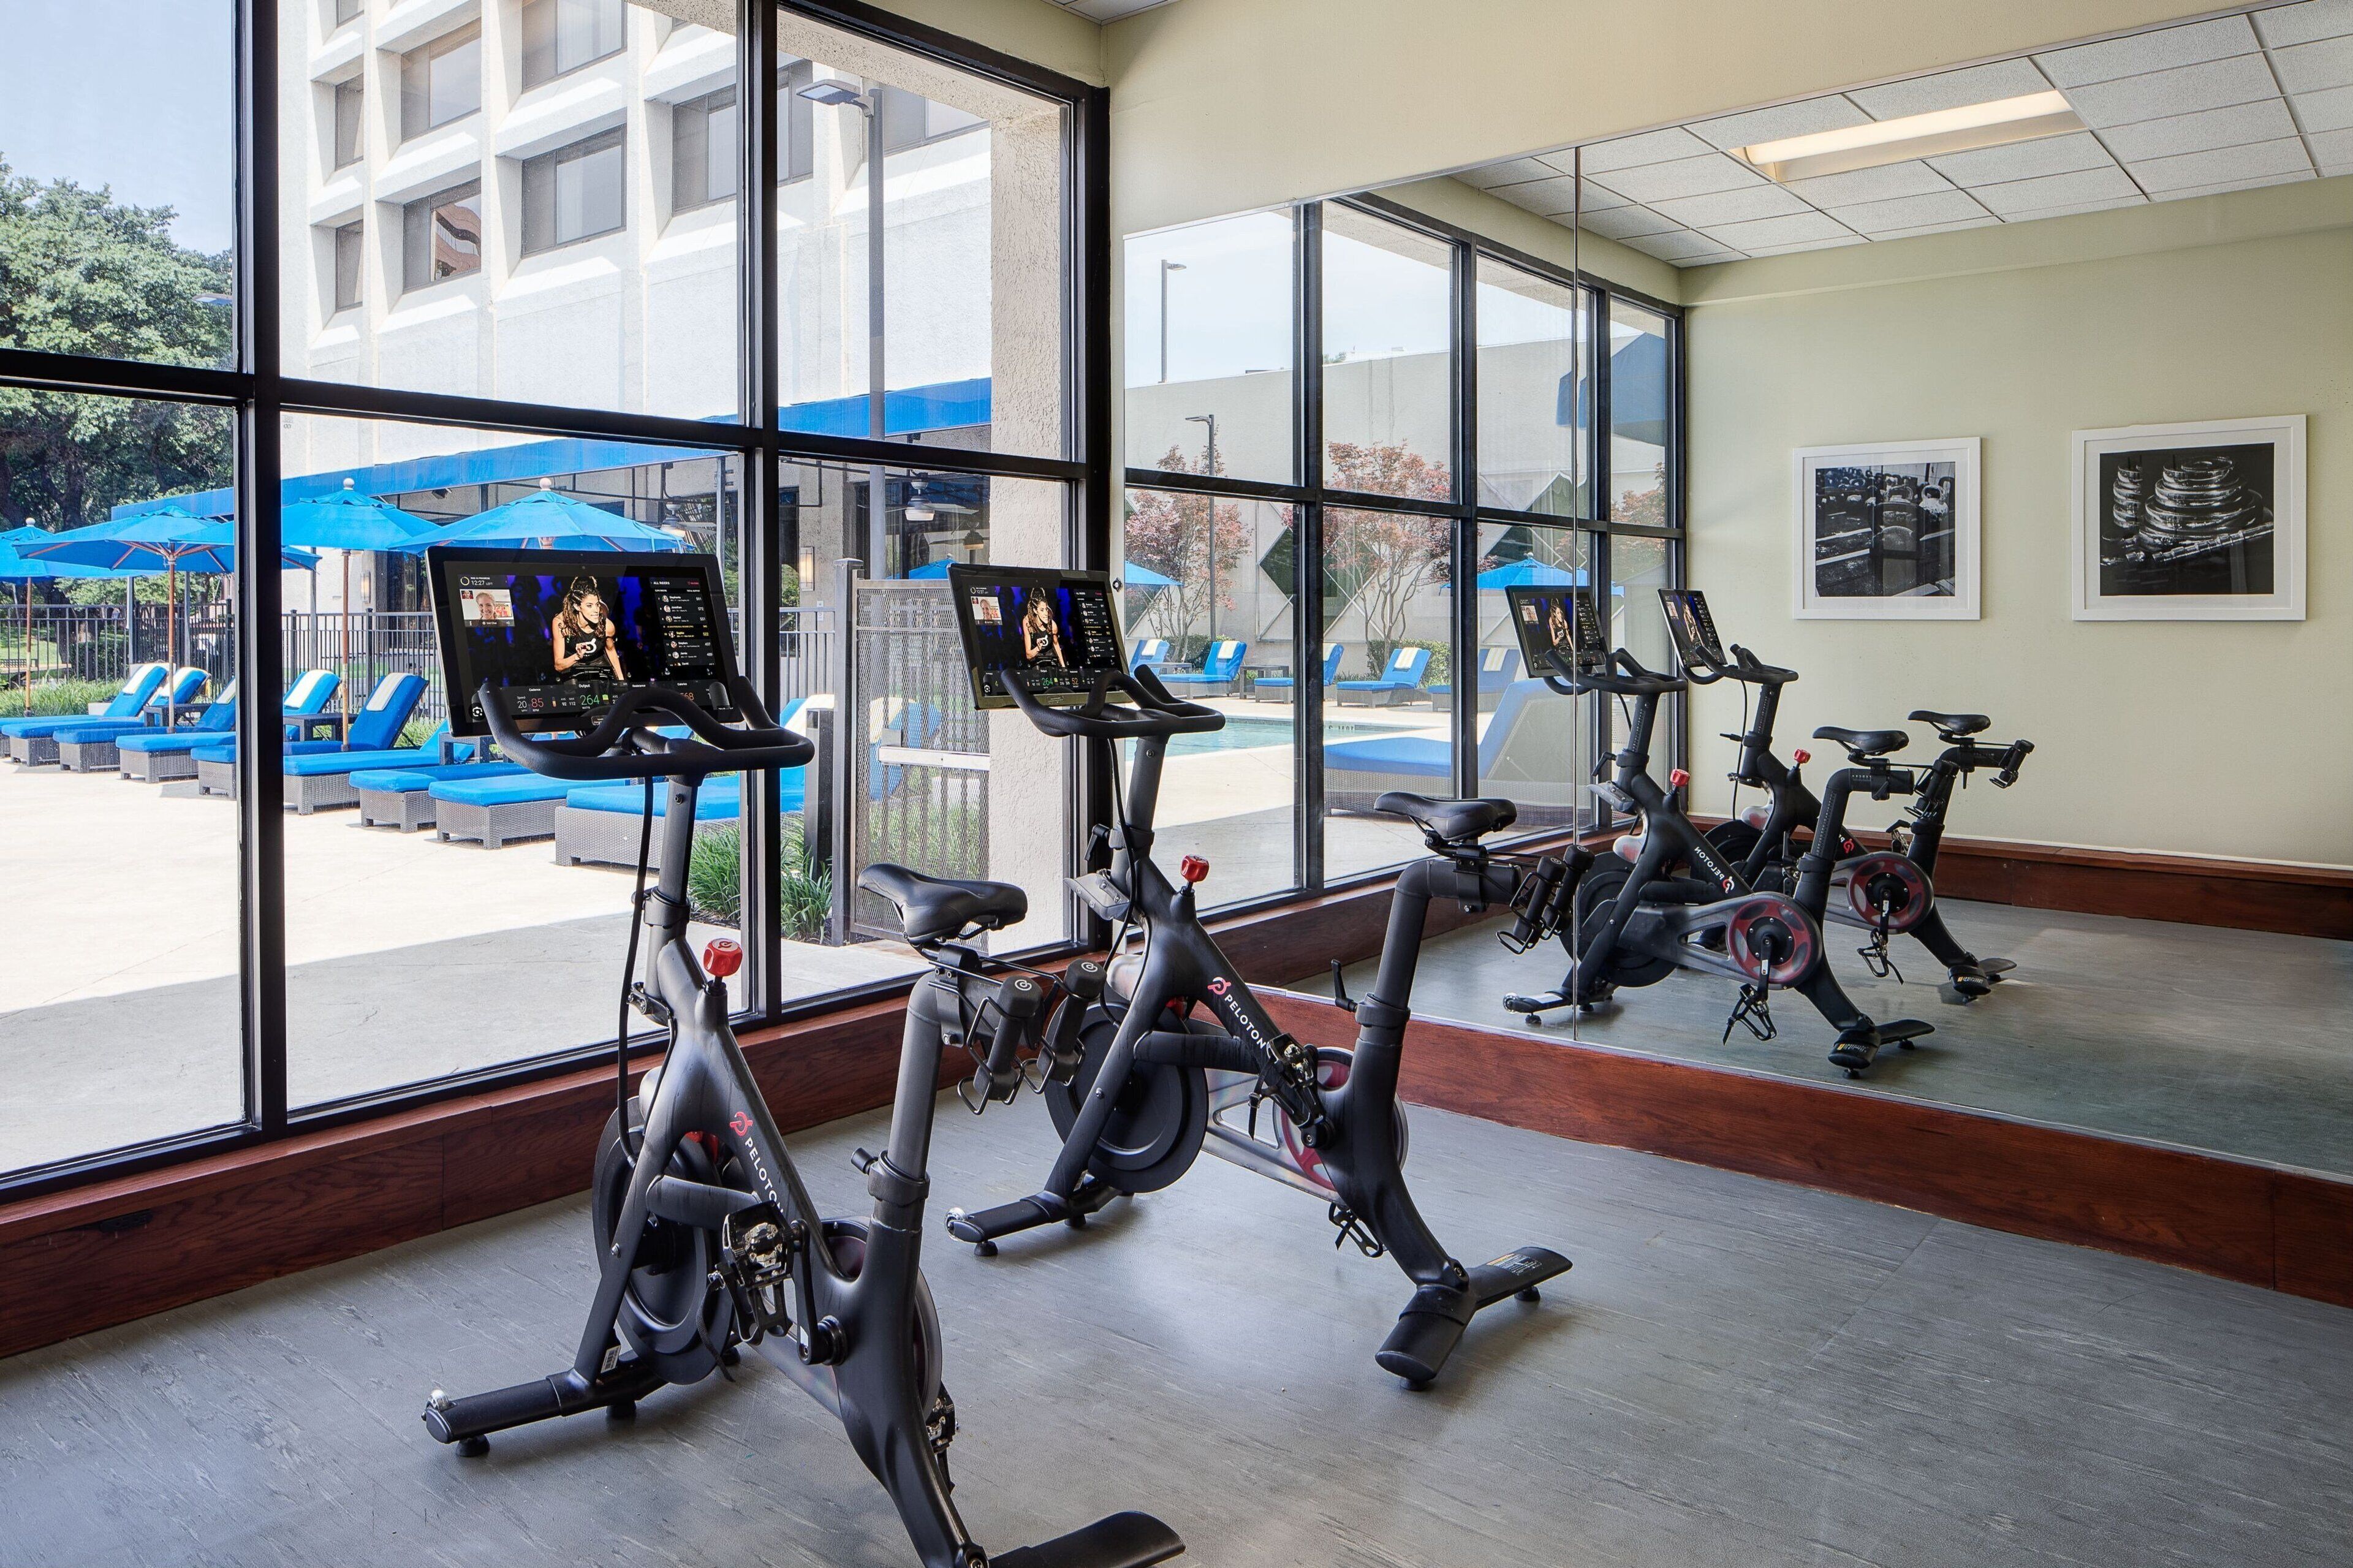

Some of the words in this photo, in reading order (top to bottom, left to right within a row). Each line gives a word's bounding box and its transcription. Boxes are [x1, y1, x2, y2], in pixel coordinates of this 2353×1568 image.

[531, 698, 544, 708] 85
[580, 695, 600, 705] 264
[1224, 994, 1267, 1049] PELOTON
[745, 1137, 784, 1213] PELOTO
